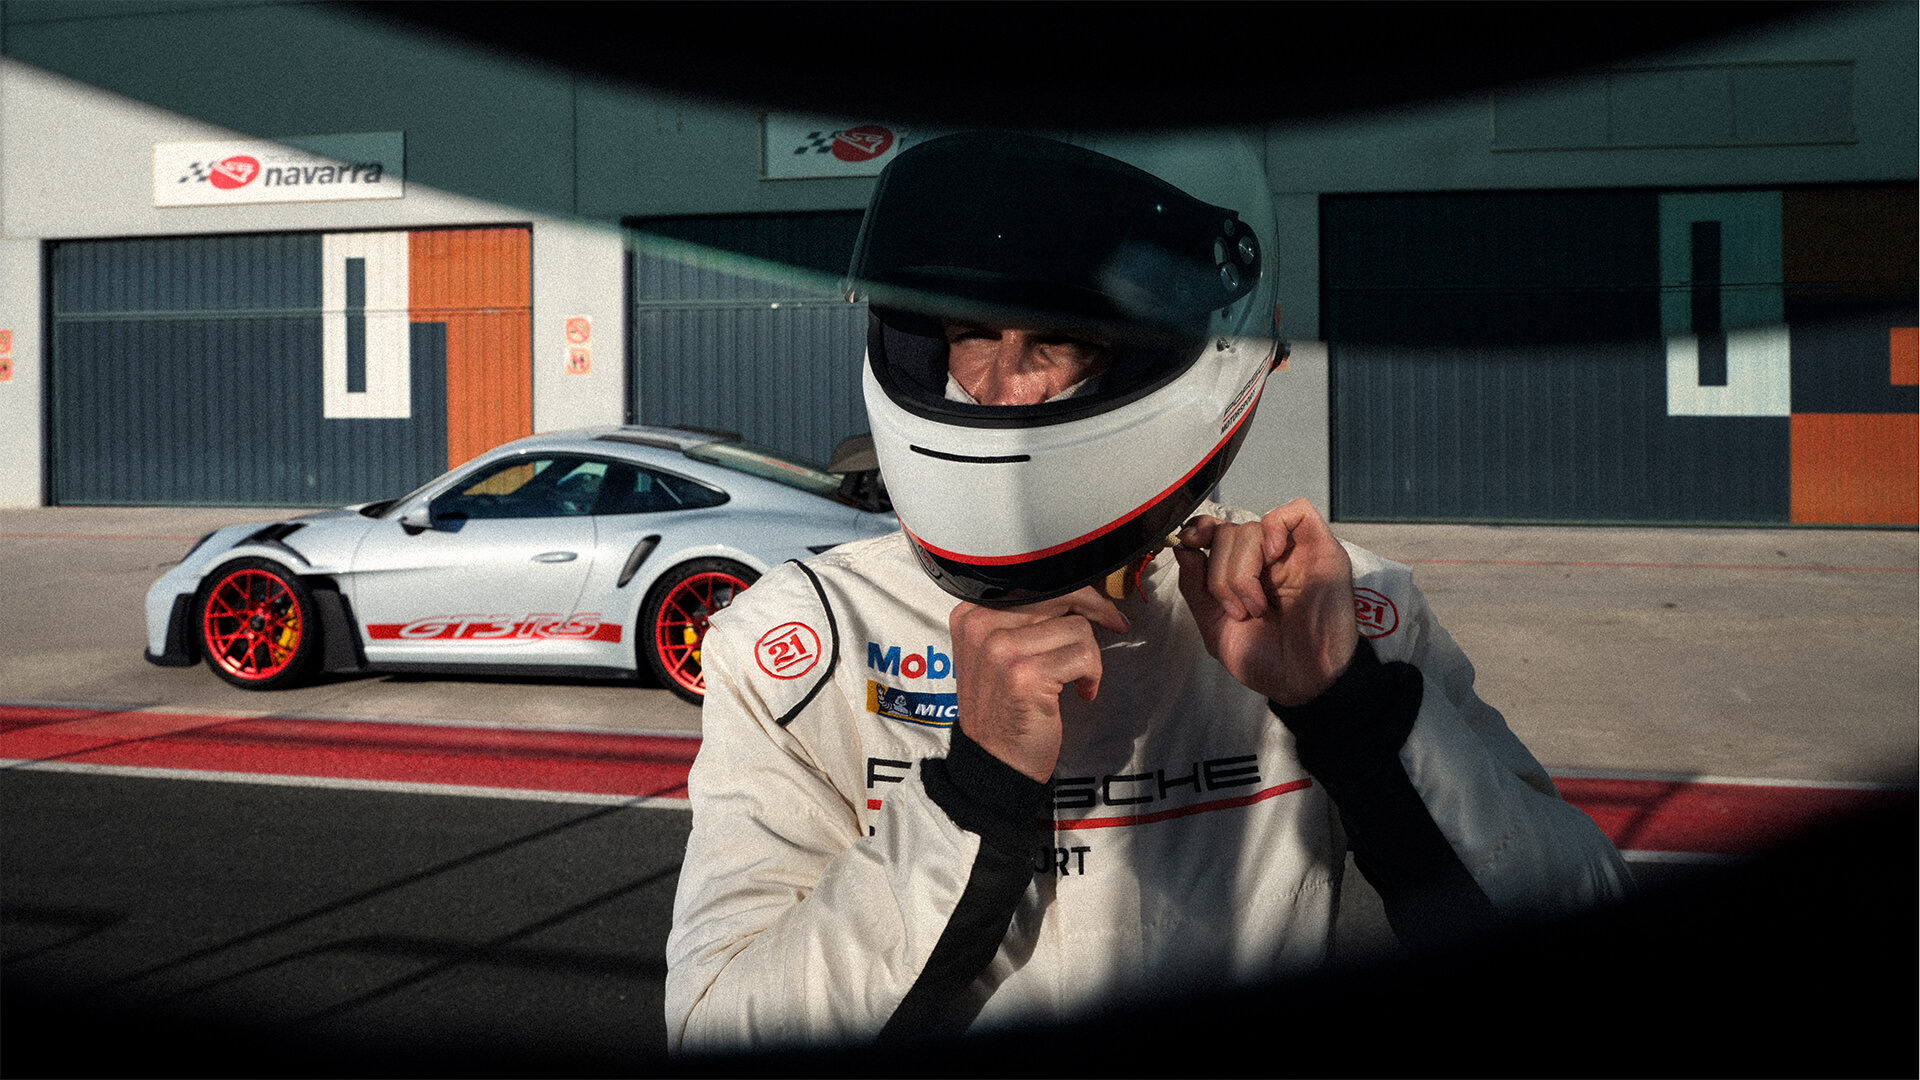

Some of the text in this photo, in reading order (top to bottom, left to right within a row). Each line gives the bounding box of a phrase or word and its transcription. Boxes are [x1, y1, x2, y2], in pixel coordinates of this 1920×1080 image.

[265, 161, 383, 186] navarra
[768, 633, 806, 666] 21
[915, 703, 959, 718] MIC
[867, 754, 1262, 808] PSCHE
